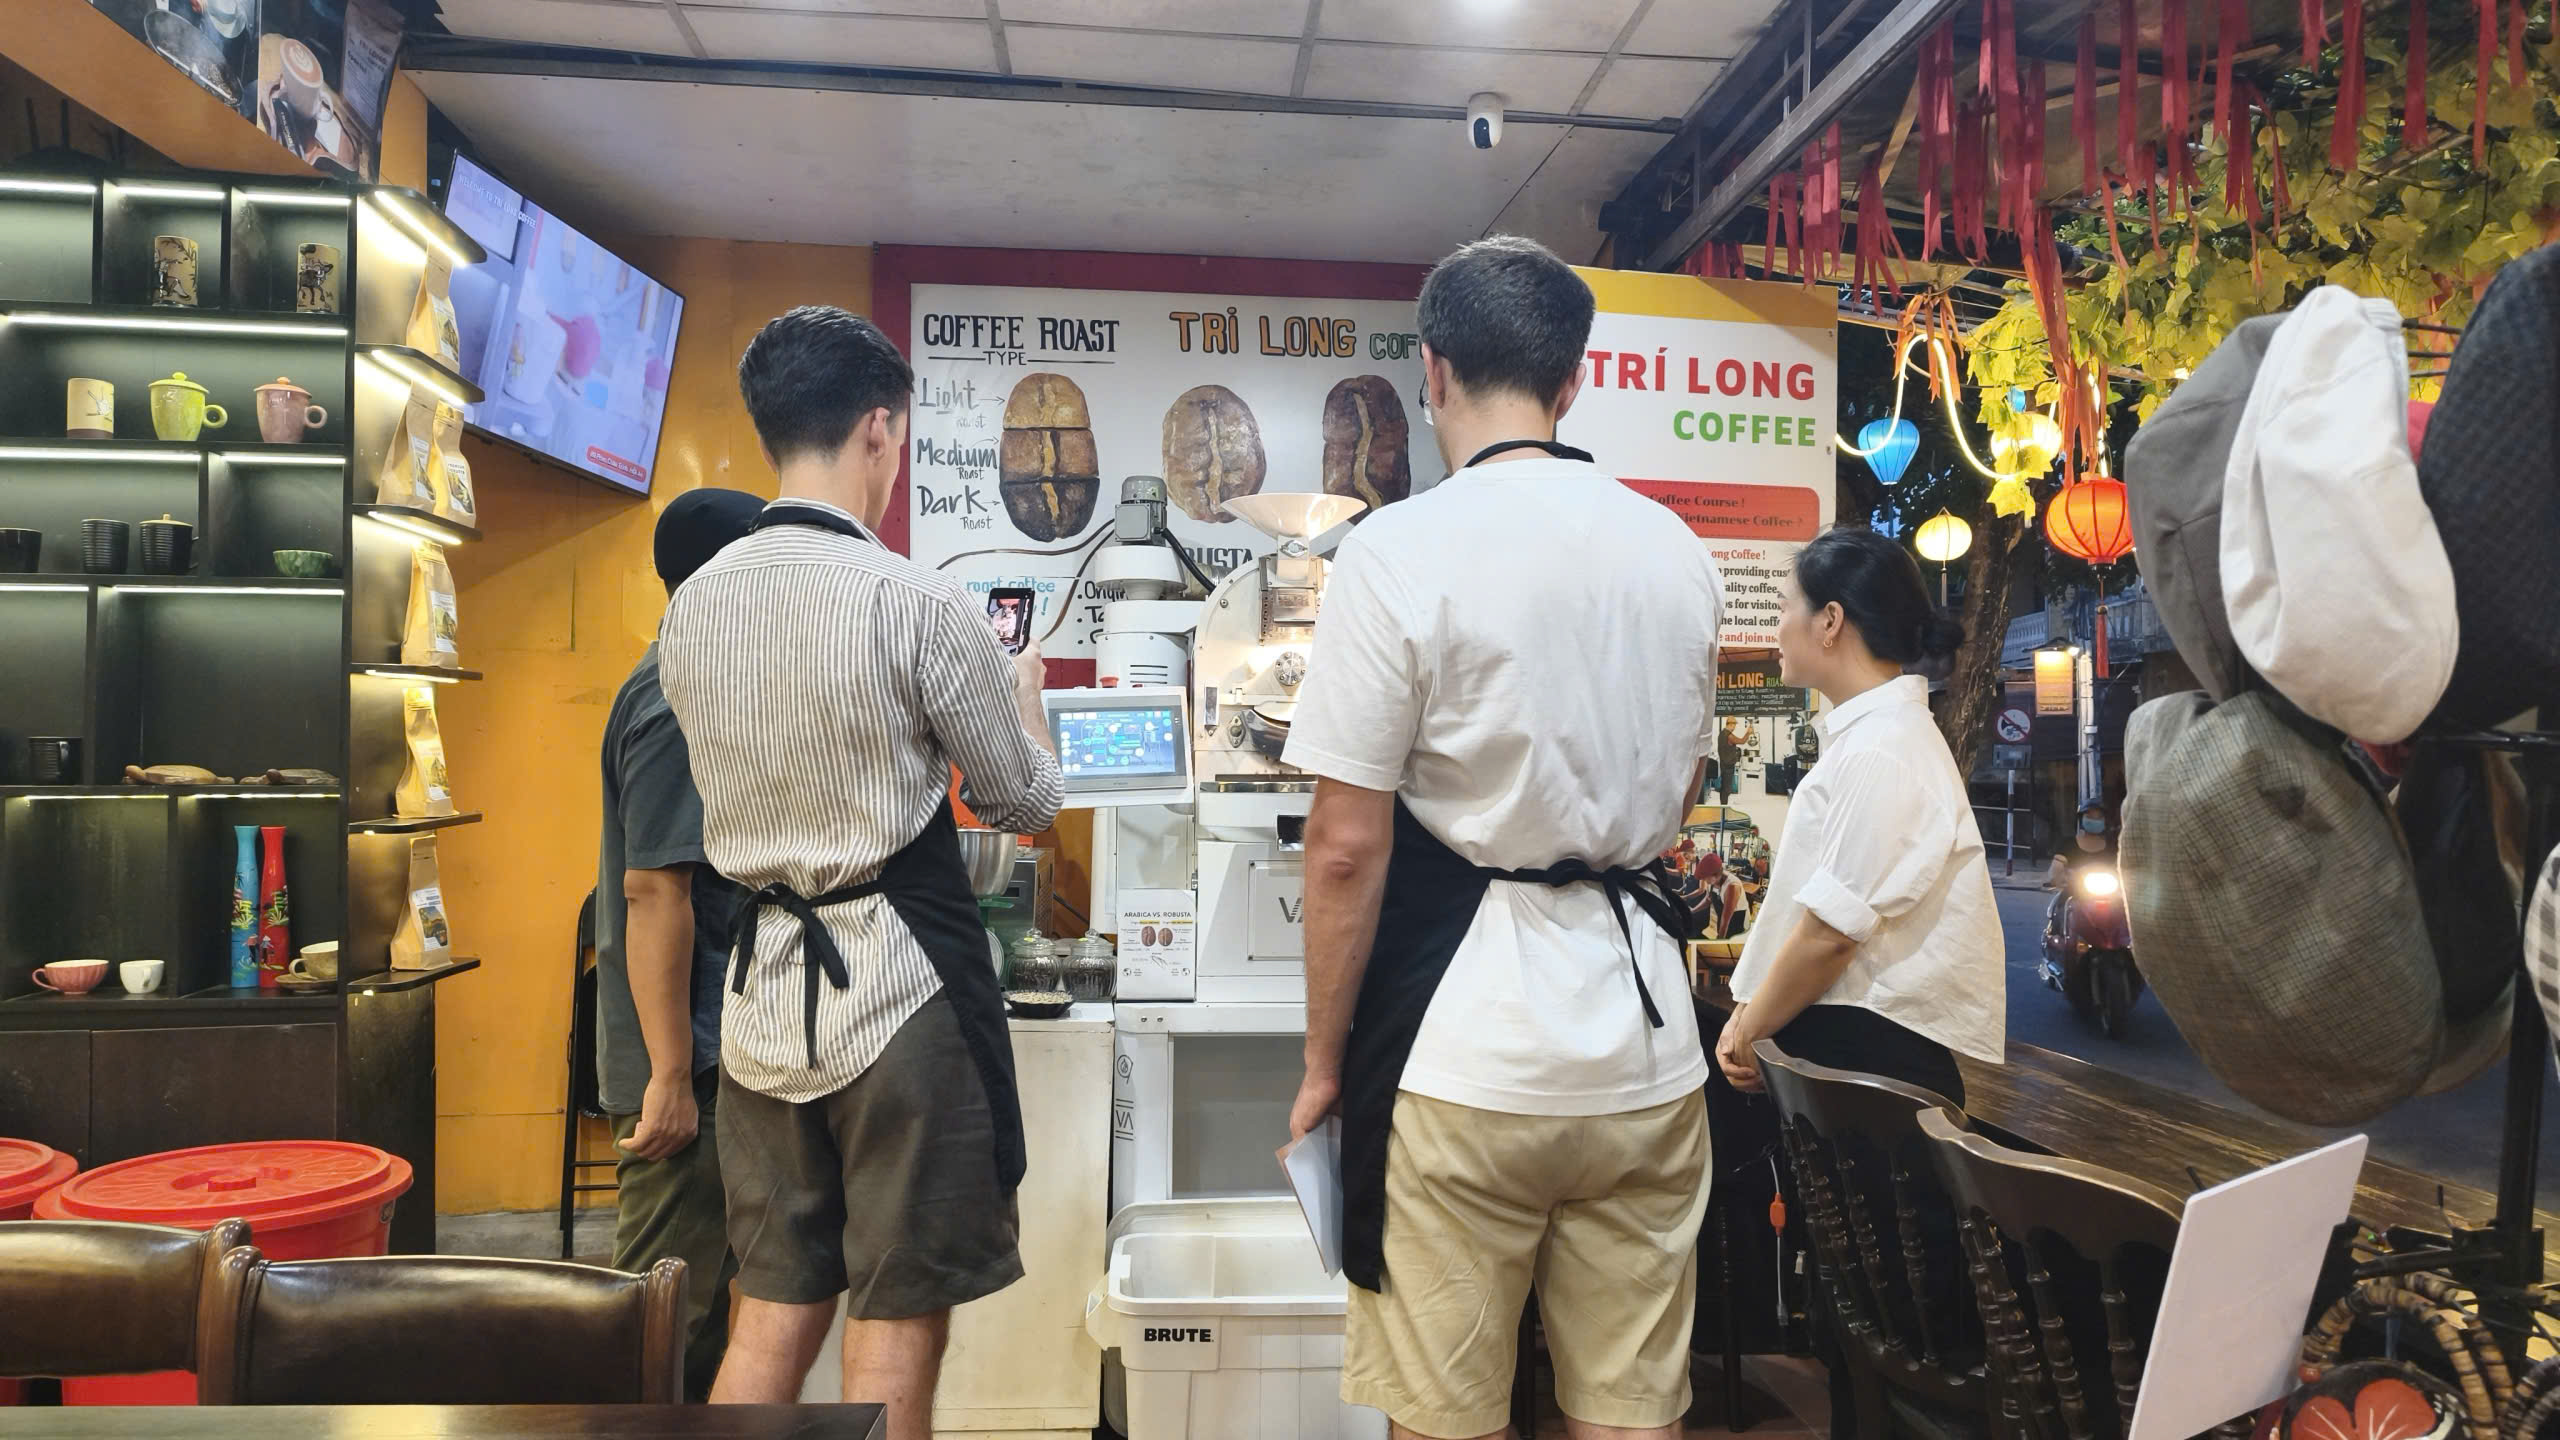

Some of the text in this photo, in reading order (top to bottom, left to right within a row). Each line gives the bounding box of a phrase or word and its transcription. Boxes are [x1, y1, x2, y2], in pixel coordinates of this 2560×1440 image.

[518, 211, 537, 229] COFFEE
[924, 313, 1120, 352] COFFEE ROAST
[1259, 315, 1357, 358] LONG
[1369, 333, 1422, 360] COF
[983, 351, 1027, 366] TYPE
[1587, 347, 1815, 401] TRÍ LONG
[919, 378, 980, 414] Light
[1673, 410, 1816, 447] COFFEE
[916, 437, 998, 470] Medium
[956, 467, 985, 480] Roast
[1694, 495, 1738, 508] Course
[960, 516, 993, 530] Roast
[1753, 514, 1793, 528] Coffee
[1709, 549, 1729, 561] ong
[1731, 549, 1760, 560] Coffee
[1723, 566, 1770, 580] providing
[1725, 582, 1747, 595] ality
[1734, 598, 1749, 609] for
[1720, 616, 1733, 626] he
[1734, 615, 1757, 626] local
[1724, 632, 1743, 643] and
[1744, 632, 1763, 645] join
[1728, 672, 1764, 689] LONG
